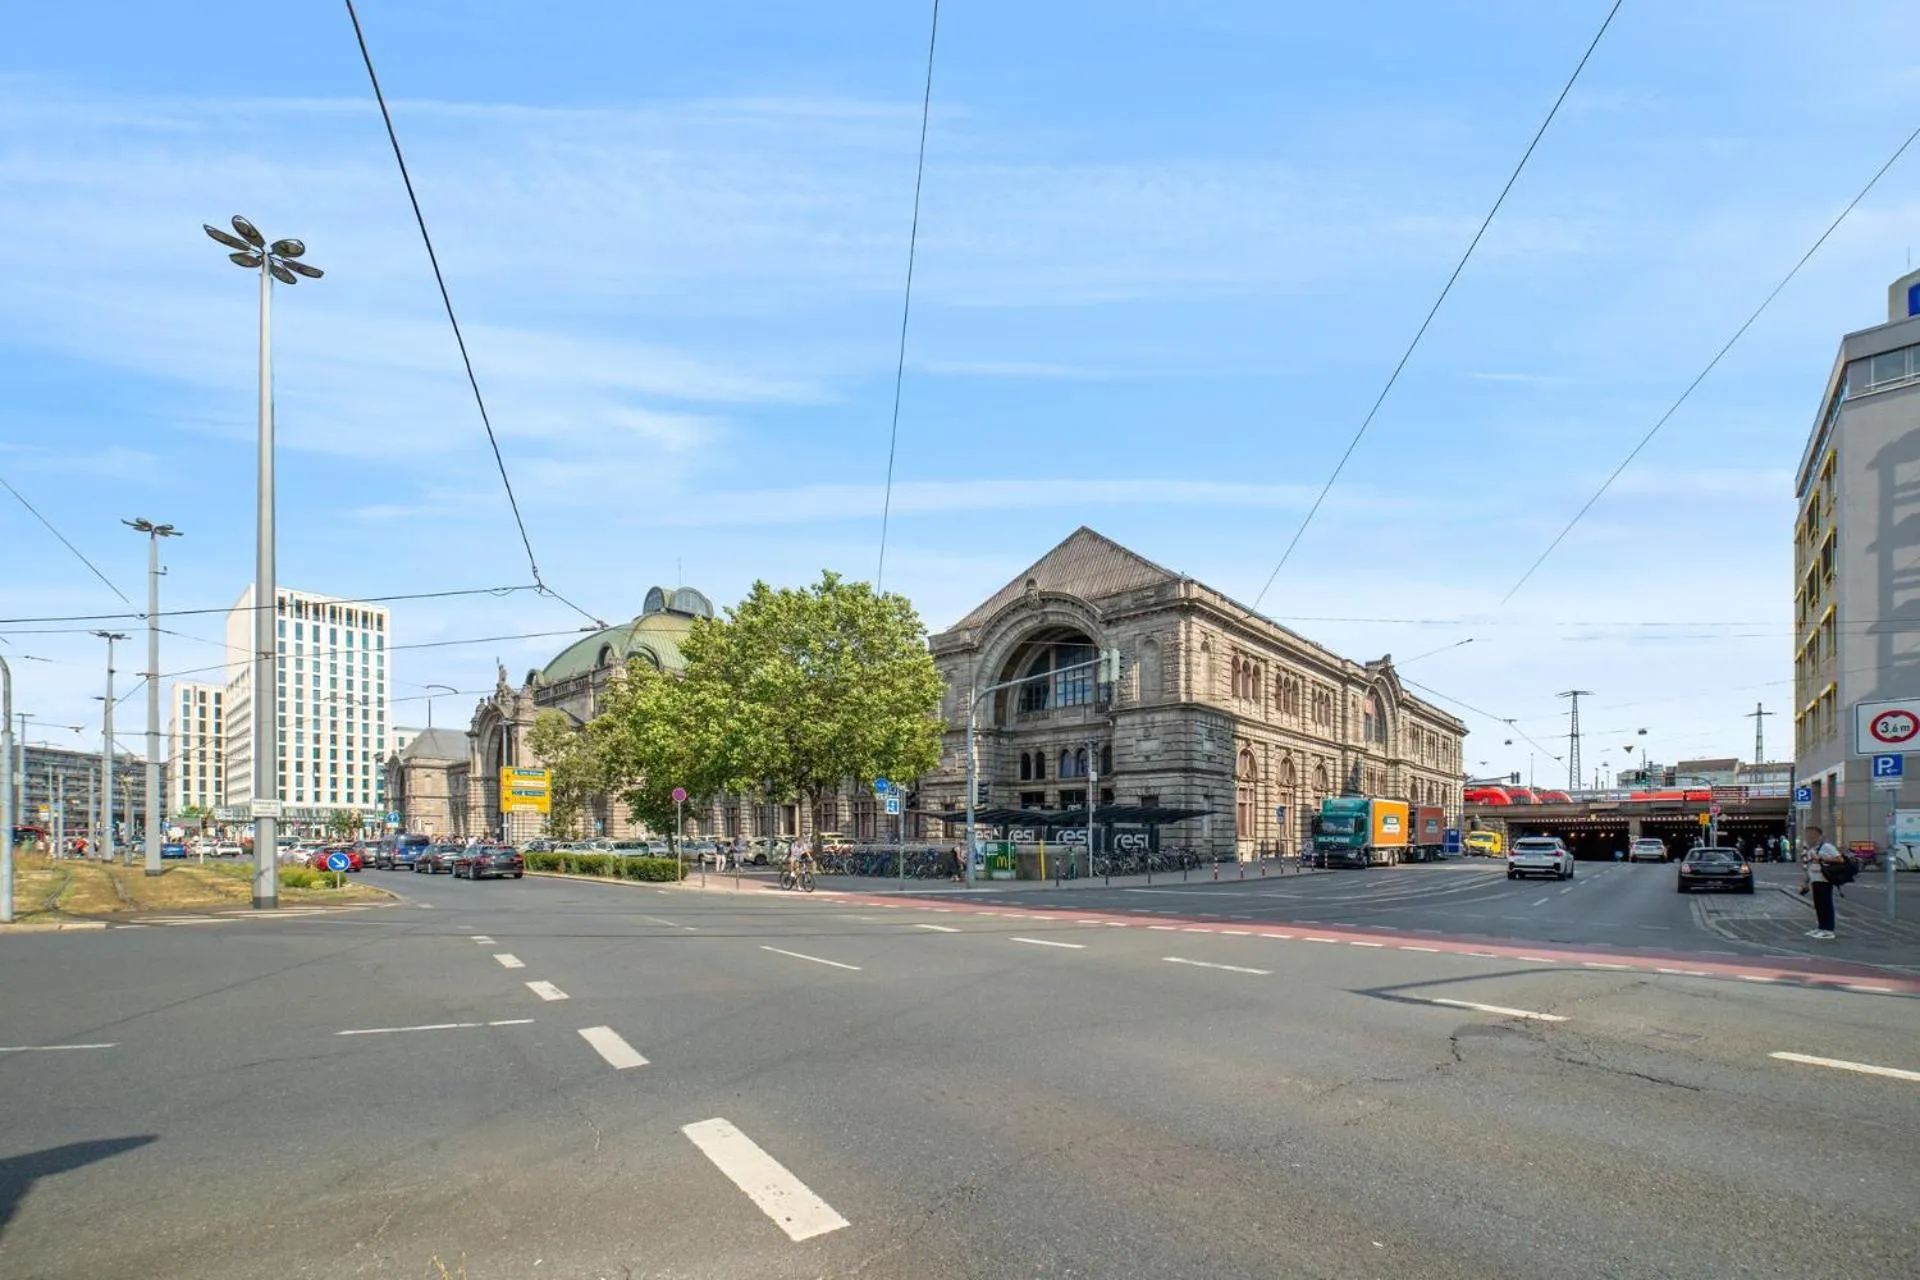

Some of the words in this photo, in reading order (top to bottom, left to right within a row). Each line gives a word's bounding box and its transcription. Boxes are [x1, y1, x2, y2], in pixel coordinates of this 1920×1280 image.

[1881, 721, 1898, 734] 3,6
[1900, 724, 1911, 733] m
[1878, 757, 1894, 775] P
[1798, 789, 1808, 801] P
